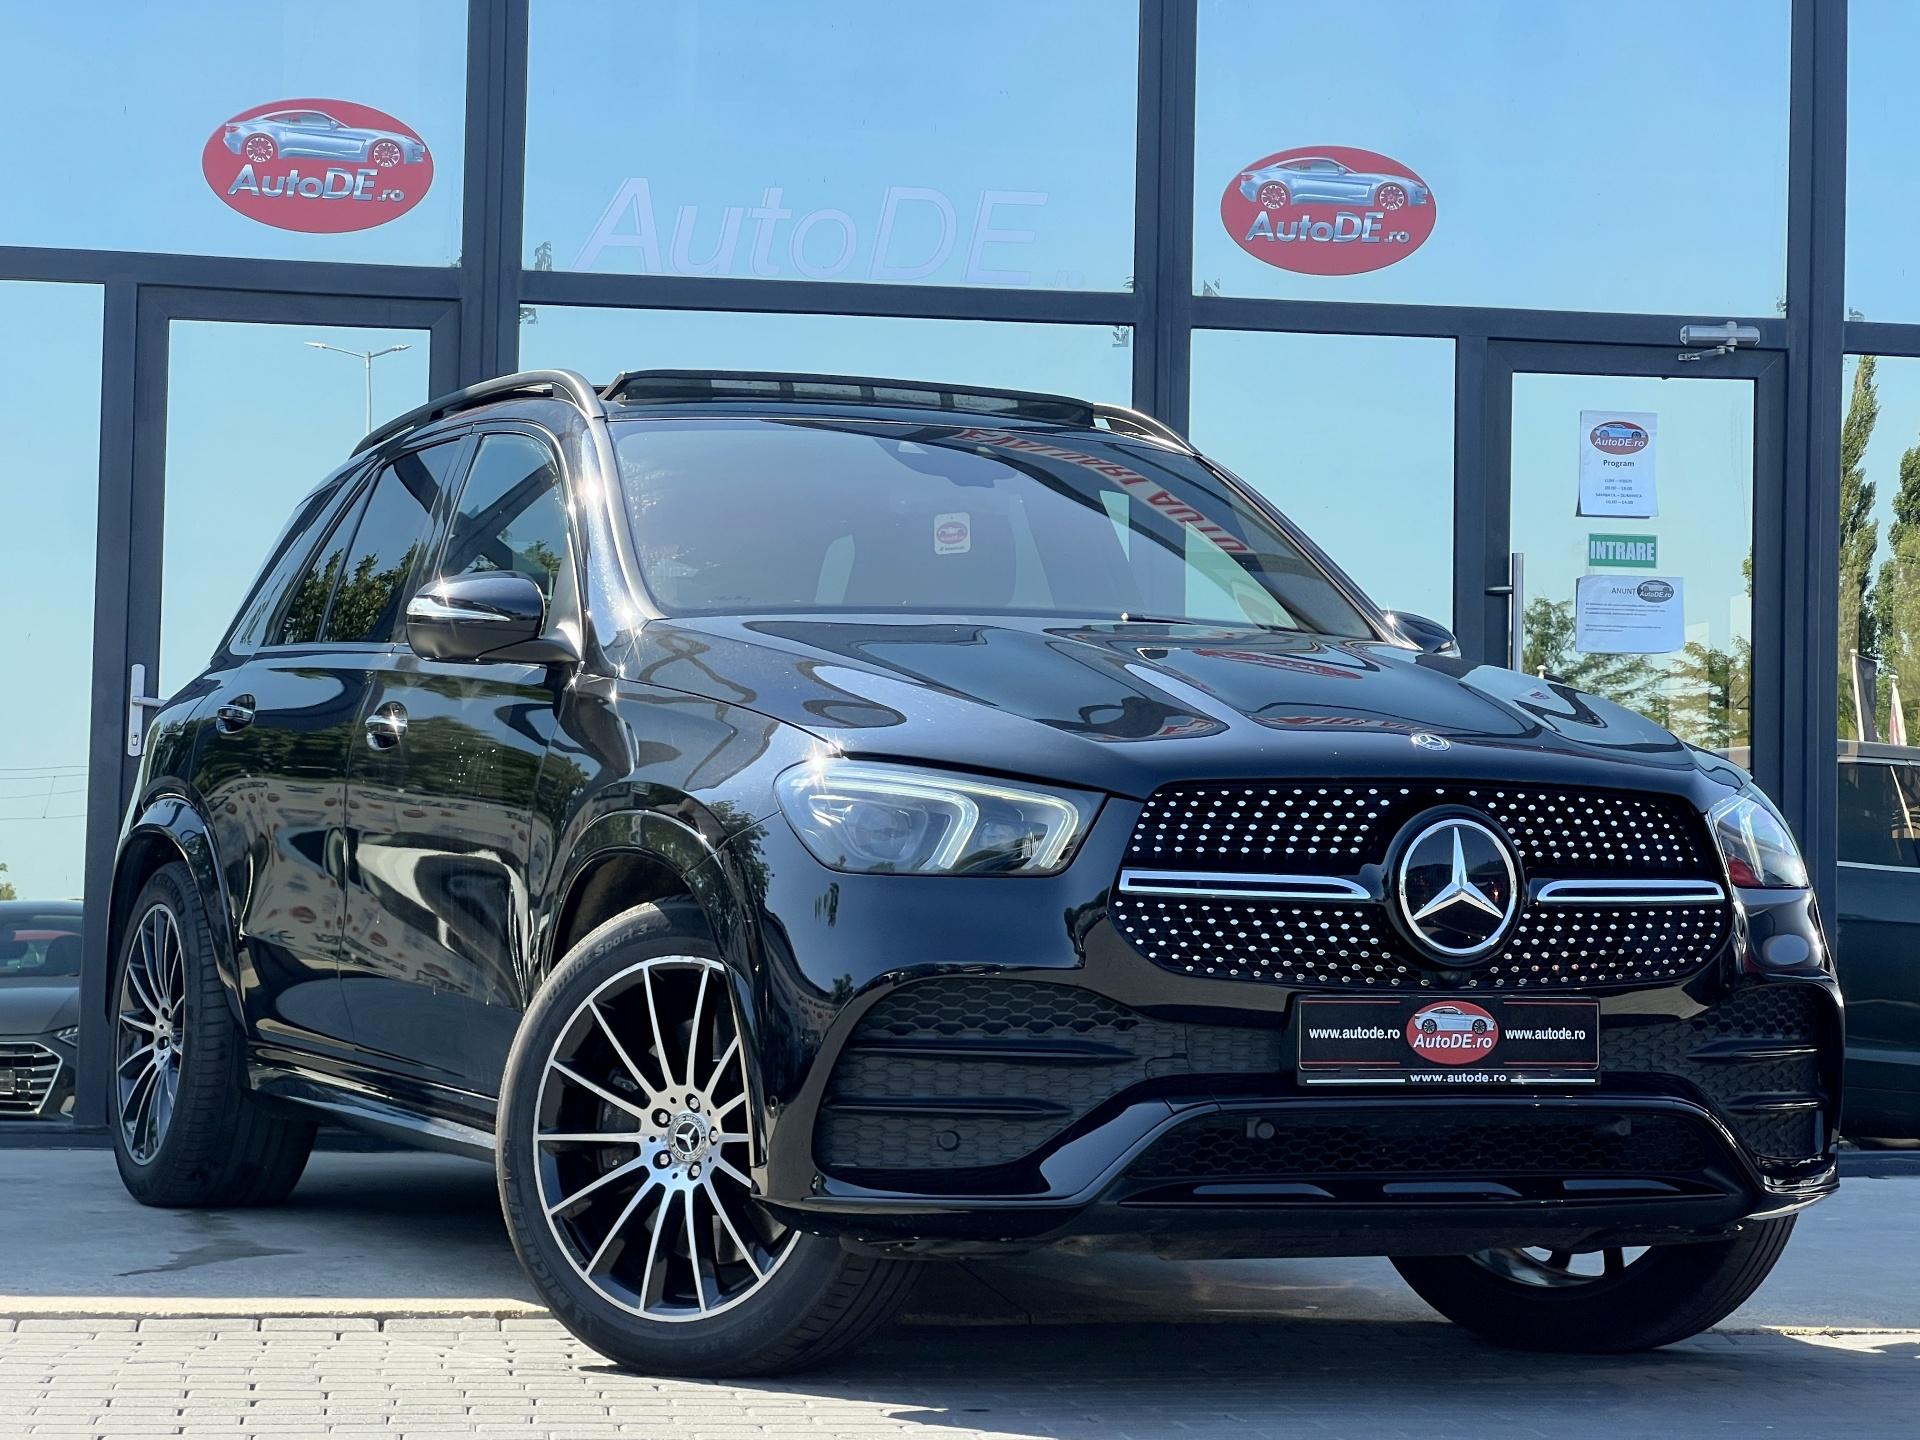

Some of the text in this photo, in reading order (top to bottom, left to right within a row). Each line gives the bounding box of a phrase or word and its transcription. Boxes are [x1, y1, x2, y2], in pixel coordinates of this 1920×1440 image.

[227, 164, 405, 202] AutoDE.ro
[1244, 210, 1410, 244] AutoDE.ro
[1594, 437, 1645, 448] AutoDE.ro
[1603, 459, 1635, 468] Program
[1590, 540, 1655, 561] INTRARE
[1308, 1026, 1401, 1040] www.autode.ro
[1505, 1027, 1586, 1041] www.autode.ro
[1413, 1033, 1493, 1050] AutoDE.ro
[1410, 1072, 1507, 1083] www.autode.ro
